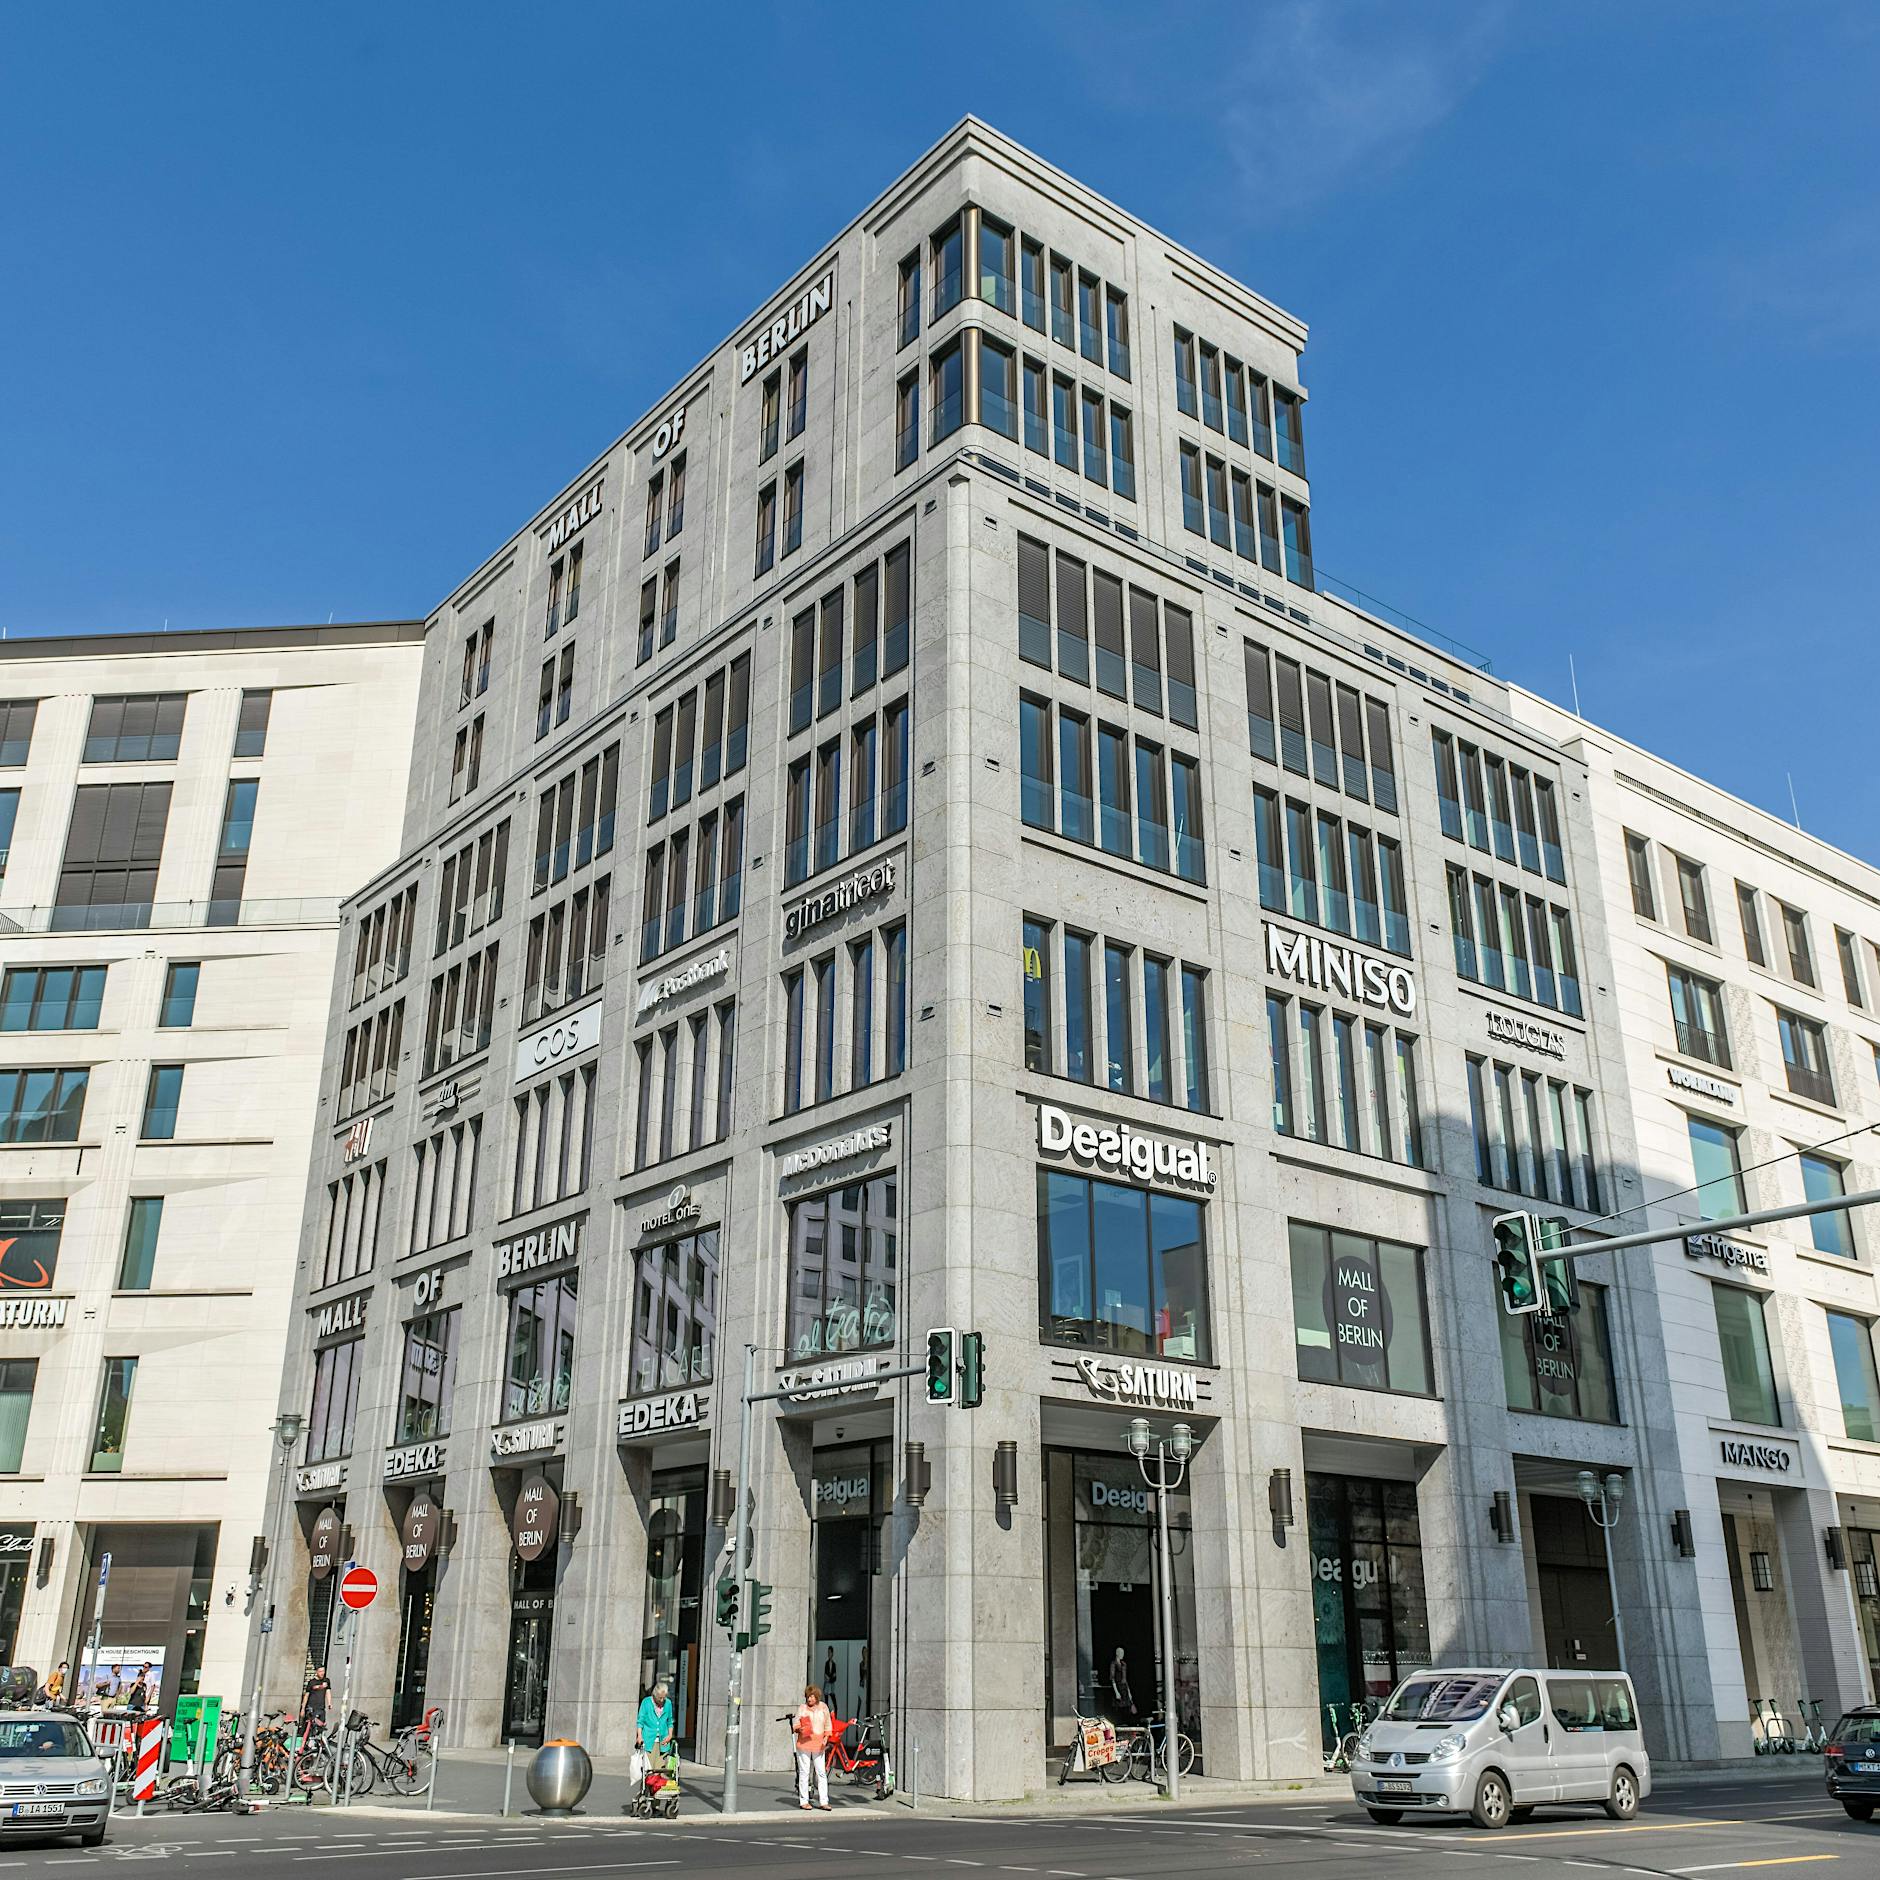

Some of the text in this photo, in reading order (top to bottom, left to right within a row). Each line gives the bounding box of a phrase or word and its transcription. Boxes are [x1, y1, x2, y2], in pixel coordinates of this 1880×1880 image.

[548, 273, 833, 550] MALL OF BERLIN
[785, 857, 896, 940] ginatricot
[662, 950, 730, 1000] Postbank
[1266, 923, 1416, 1013] MINISO
[533, 1018, 579, 1064] COS
[1491, 1010, 1567, 1055] DOUGLAS
[1668, 1067, 1737, 1104] WORMLAND
[782, 1125, 890, 1178] McDonald's
[1038, 1104, 1208, 1184] Desigual
[641, 1203, 701, 1233] MOTEL ONE
[1710, 1236, 1768, 1270] trigema
[318, 1220, 577, 1338] MALL OF BERLIN
[1338, 1267, 1375, 1293] MALL
[1348, 1297, 1368, 1319] OF
[1337, 1323, 1383, 1350] BERLIN
[1543, 1333, 1560, 1352] OF
[811, 1358, 877, 1399] SATURN
[1536, 1356, 1575, 1379] BERLIN
[1118, 1364, 1198, 1402] SATURN
[618, 1393, 698, 1435] EDEKA
[511, 1422, 556, 1453] SATURN
[383, 1446, 440, 1477] EDEKA
[1721, 1440, 1789, 1472] MANGO
[309, 1464, 341, 1491] SATURN
[816, 1472, 870, 1505] esigual
[524, 1487, 543, 1503] MALL
[318, 1518, 333, 1530] MALL
[412, 1504, 428, 1518] MALL
[526, 1508, 538, 1524] OF
[319, 1536, 328, 1548] OF
[412, 1523, 423, 1538] OF
[518, 1530, 543, 1547] BERLIN
[313, 1554, 331, 1568] BERLIN
[405, 1544, 427, 1559] BERLIN
[532, 1600, 545, 1609] OF
[19, 1806, 25, 1814] B
[42, 1804, 63, 1813] 1551
